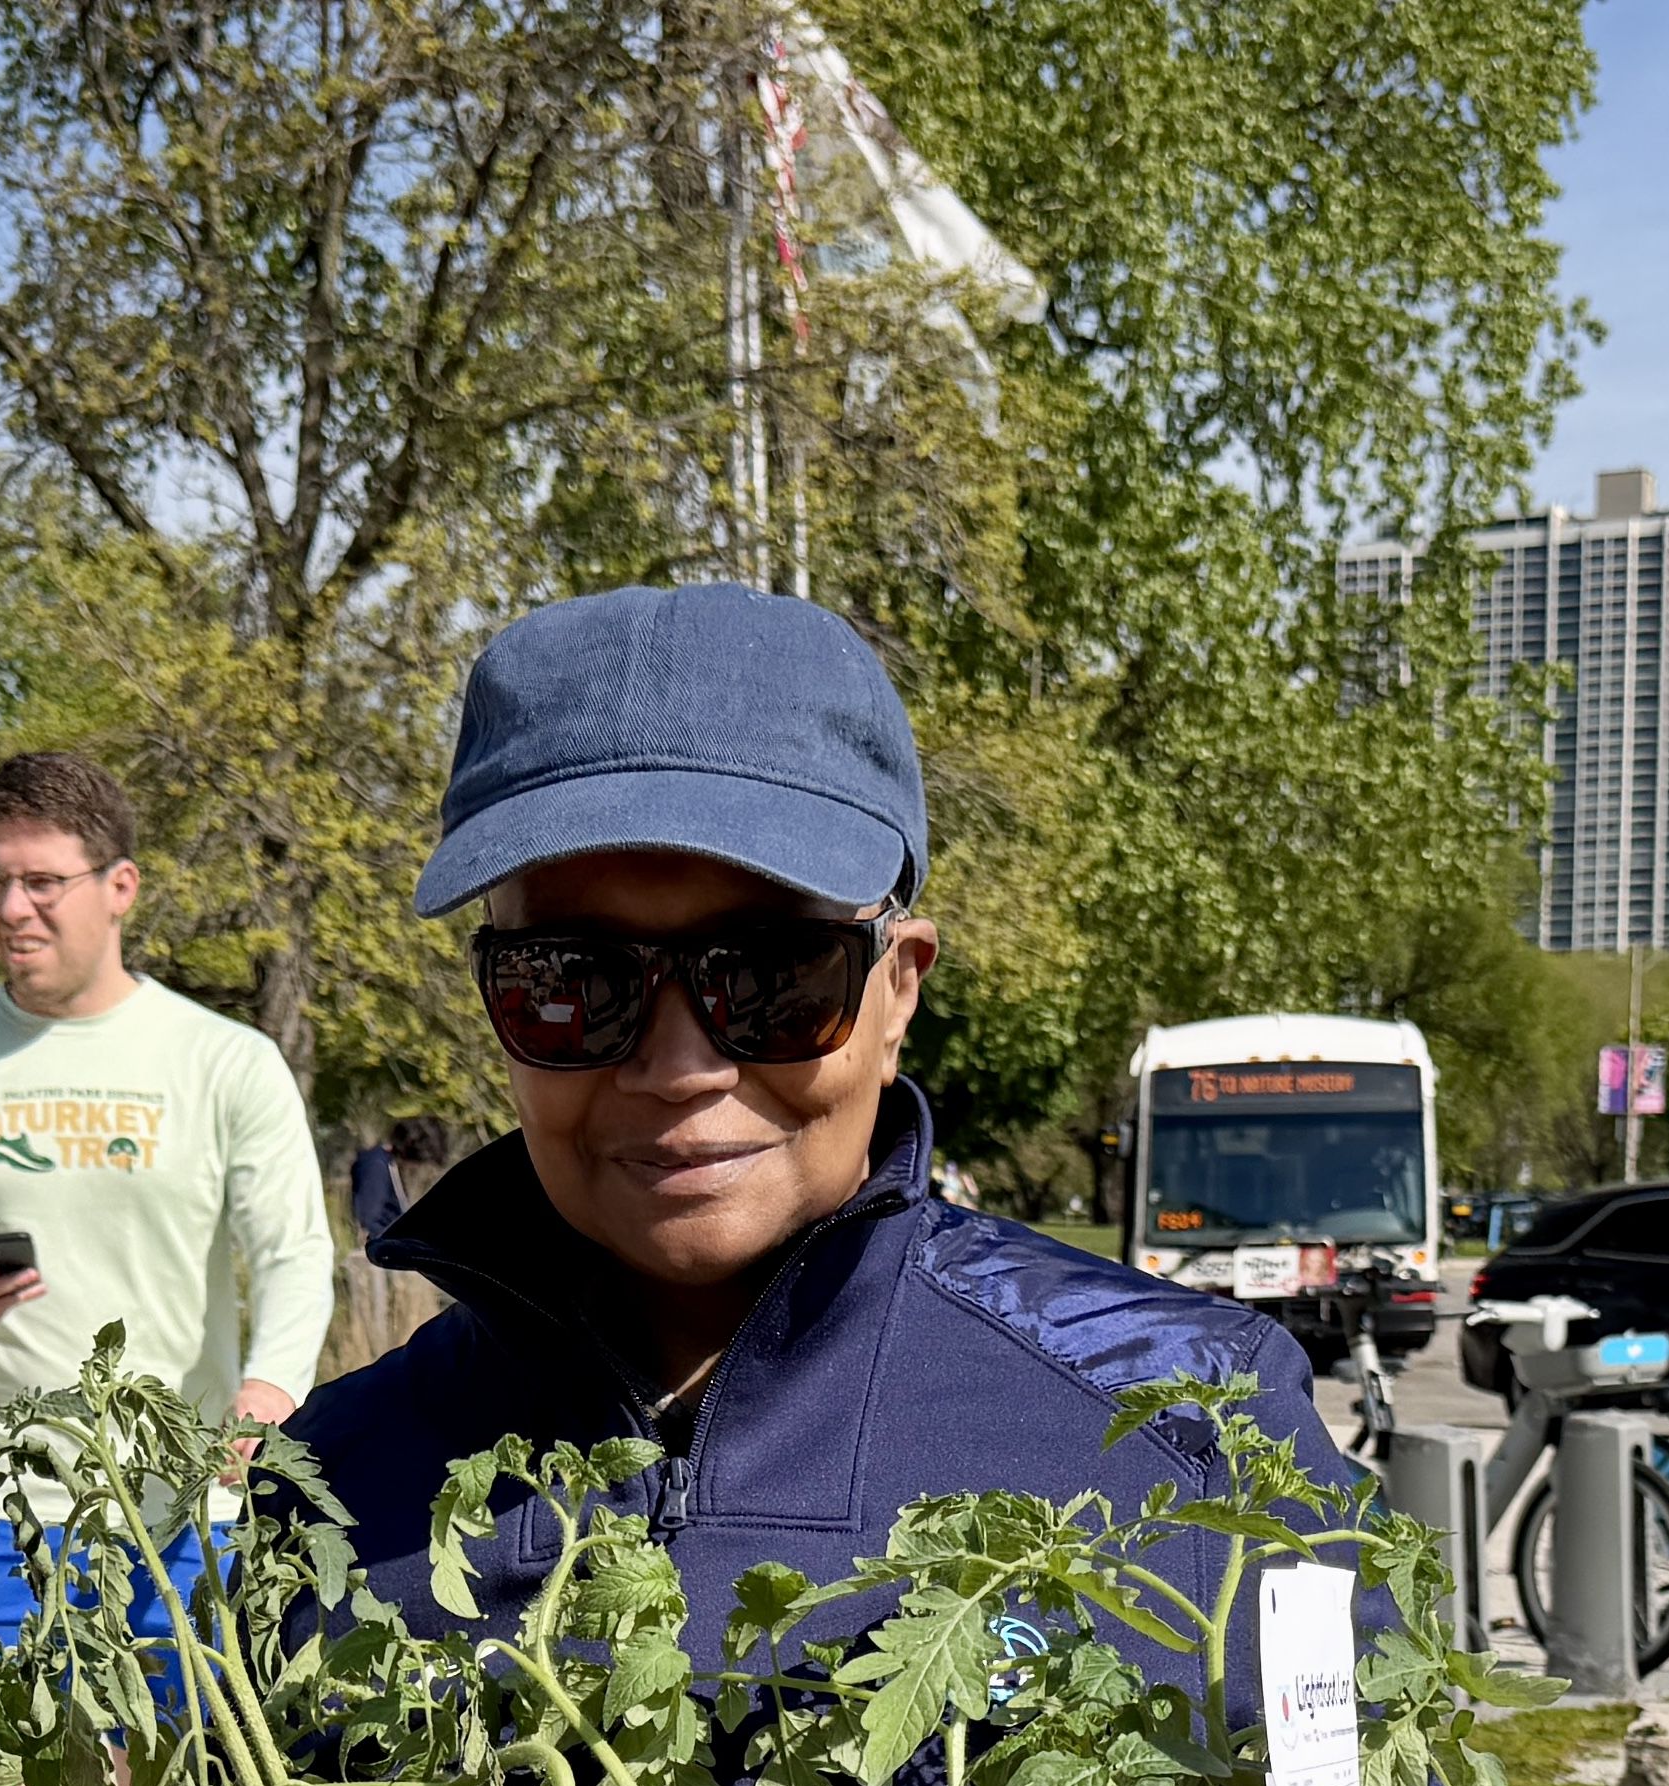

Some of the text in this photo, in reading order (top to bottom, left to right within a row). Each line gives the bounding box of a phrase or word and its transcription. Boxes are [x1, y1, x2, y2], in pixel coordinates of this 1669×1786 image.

[69, 1087, 102, 1099] PARK
[1188, 1069, 1218, 1103] 76
[1239, 1073, 1295, 1094] NATURE
[1296, 1072, 1356, 1093] MUSEUM
[2, 1101, 165, 1135] TURKEY
[54, 1136, 159, 1174] TROT
